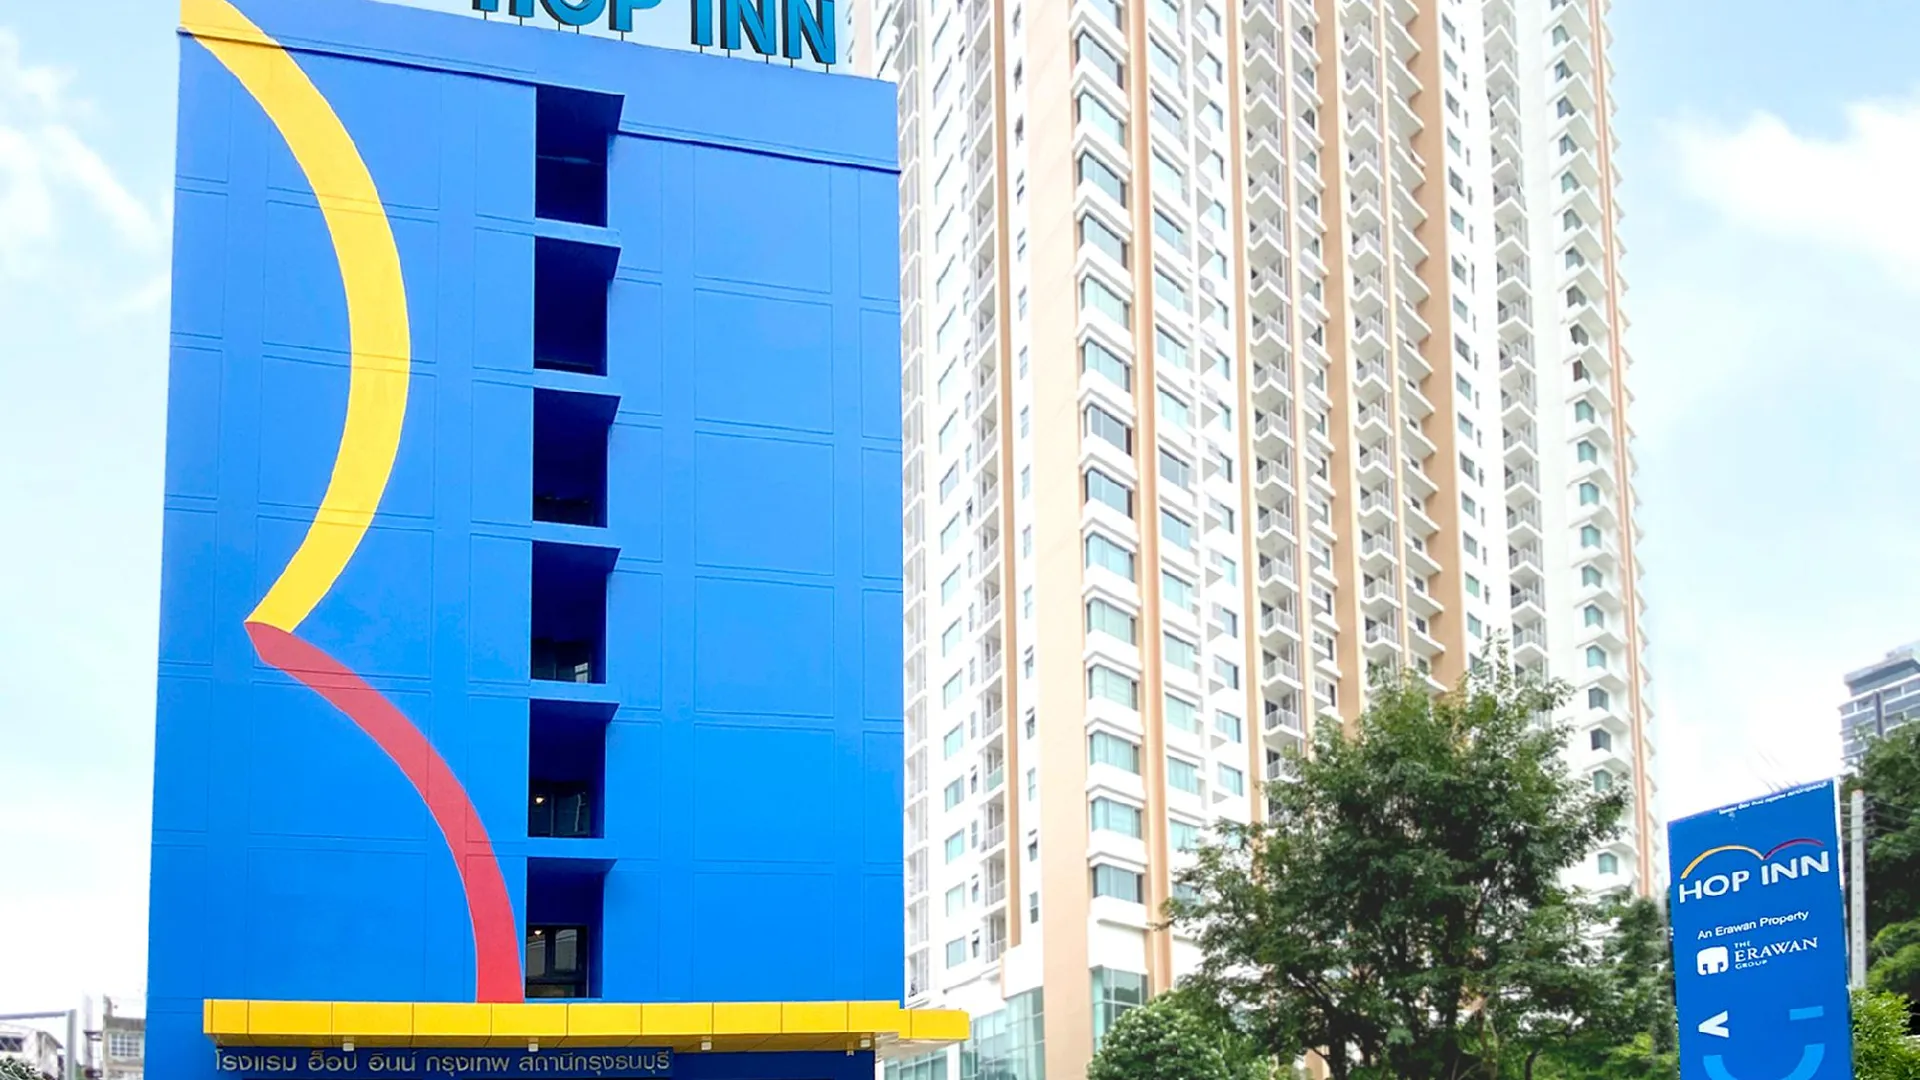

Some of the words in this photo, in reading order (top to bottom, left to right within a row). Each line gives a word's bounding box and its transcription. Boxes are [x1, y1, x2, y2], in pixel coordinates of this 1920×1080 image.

[691, 0, 836, 64] INN
[1678, 870, 1750, 904] HOP
[1761, 851, 1830, 886] INN
[1697, 930, 1713, 940] An
[1715, 921, 1757, 937] Erawan
[1759, 910, 1809, 927] Property
[1734, 936, 1818, 963] ERAWAN
[1735, 959, 1768, 970] GROUP
[214, 1048, 298, 1072] โรงแรม
[425, 1055, 511, 1077] กรุงเทพ
[518, 1050, 671, 1077] สถานีกรุงธนบุรี
